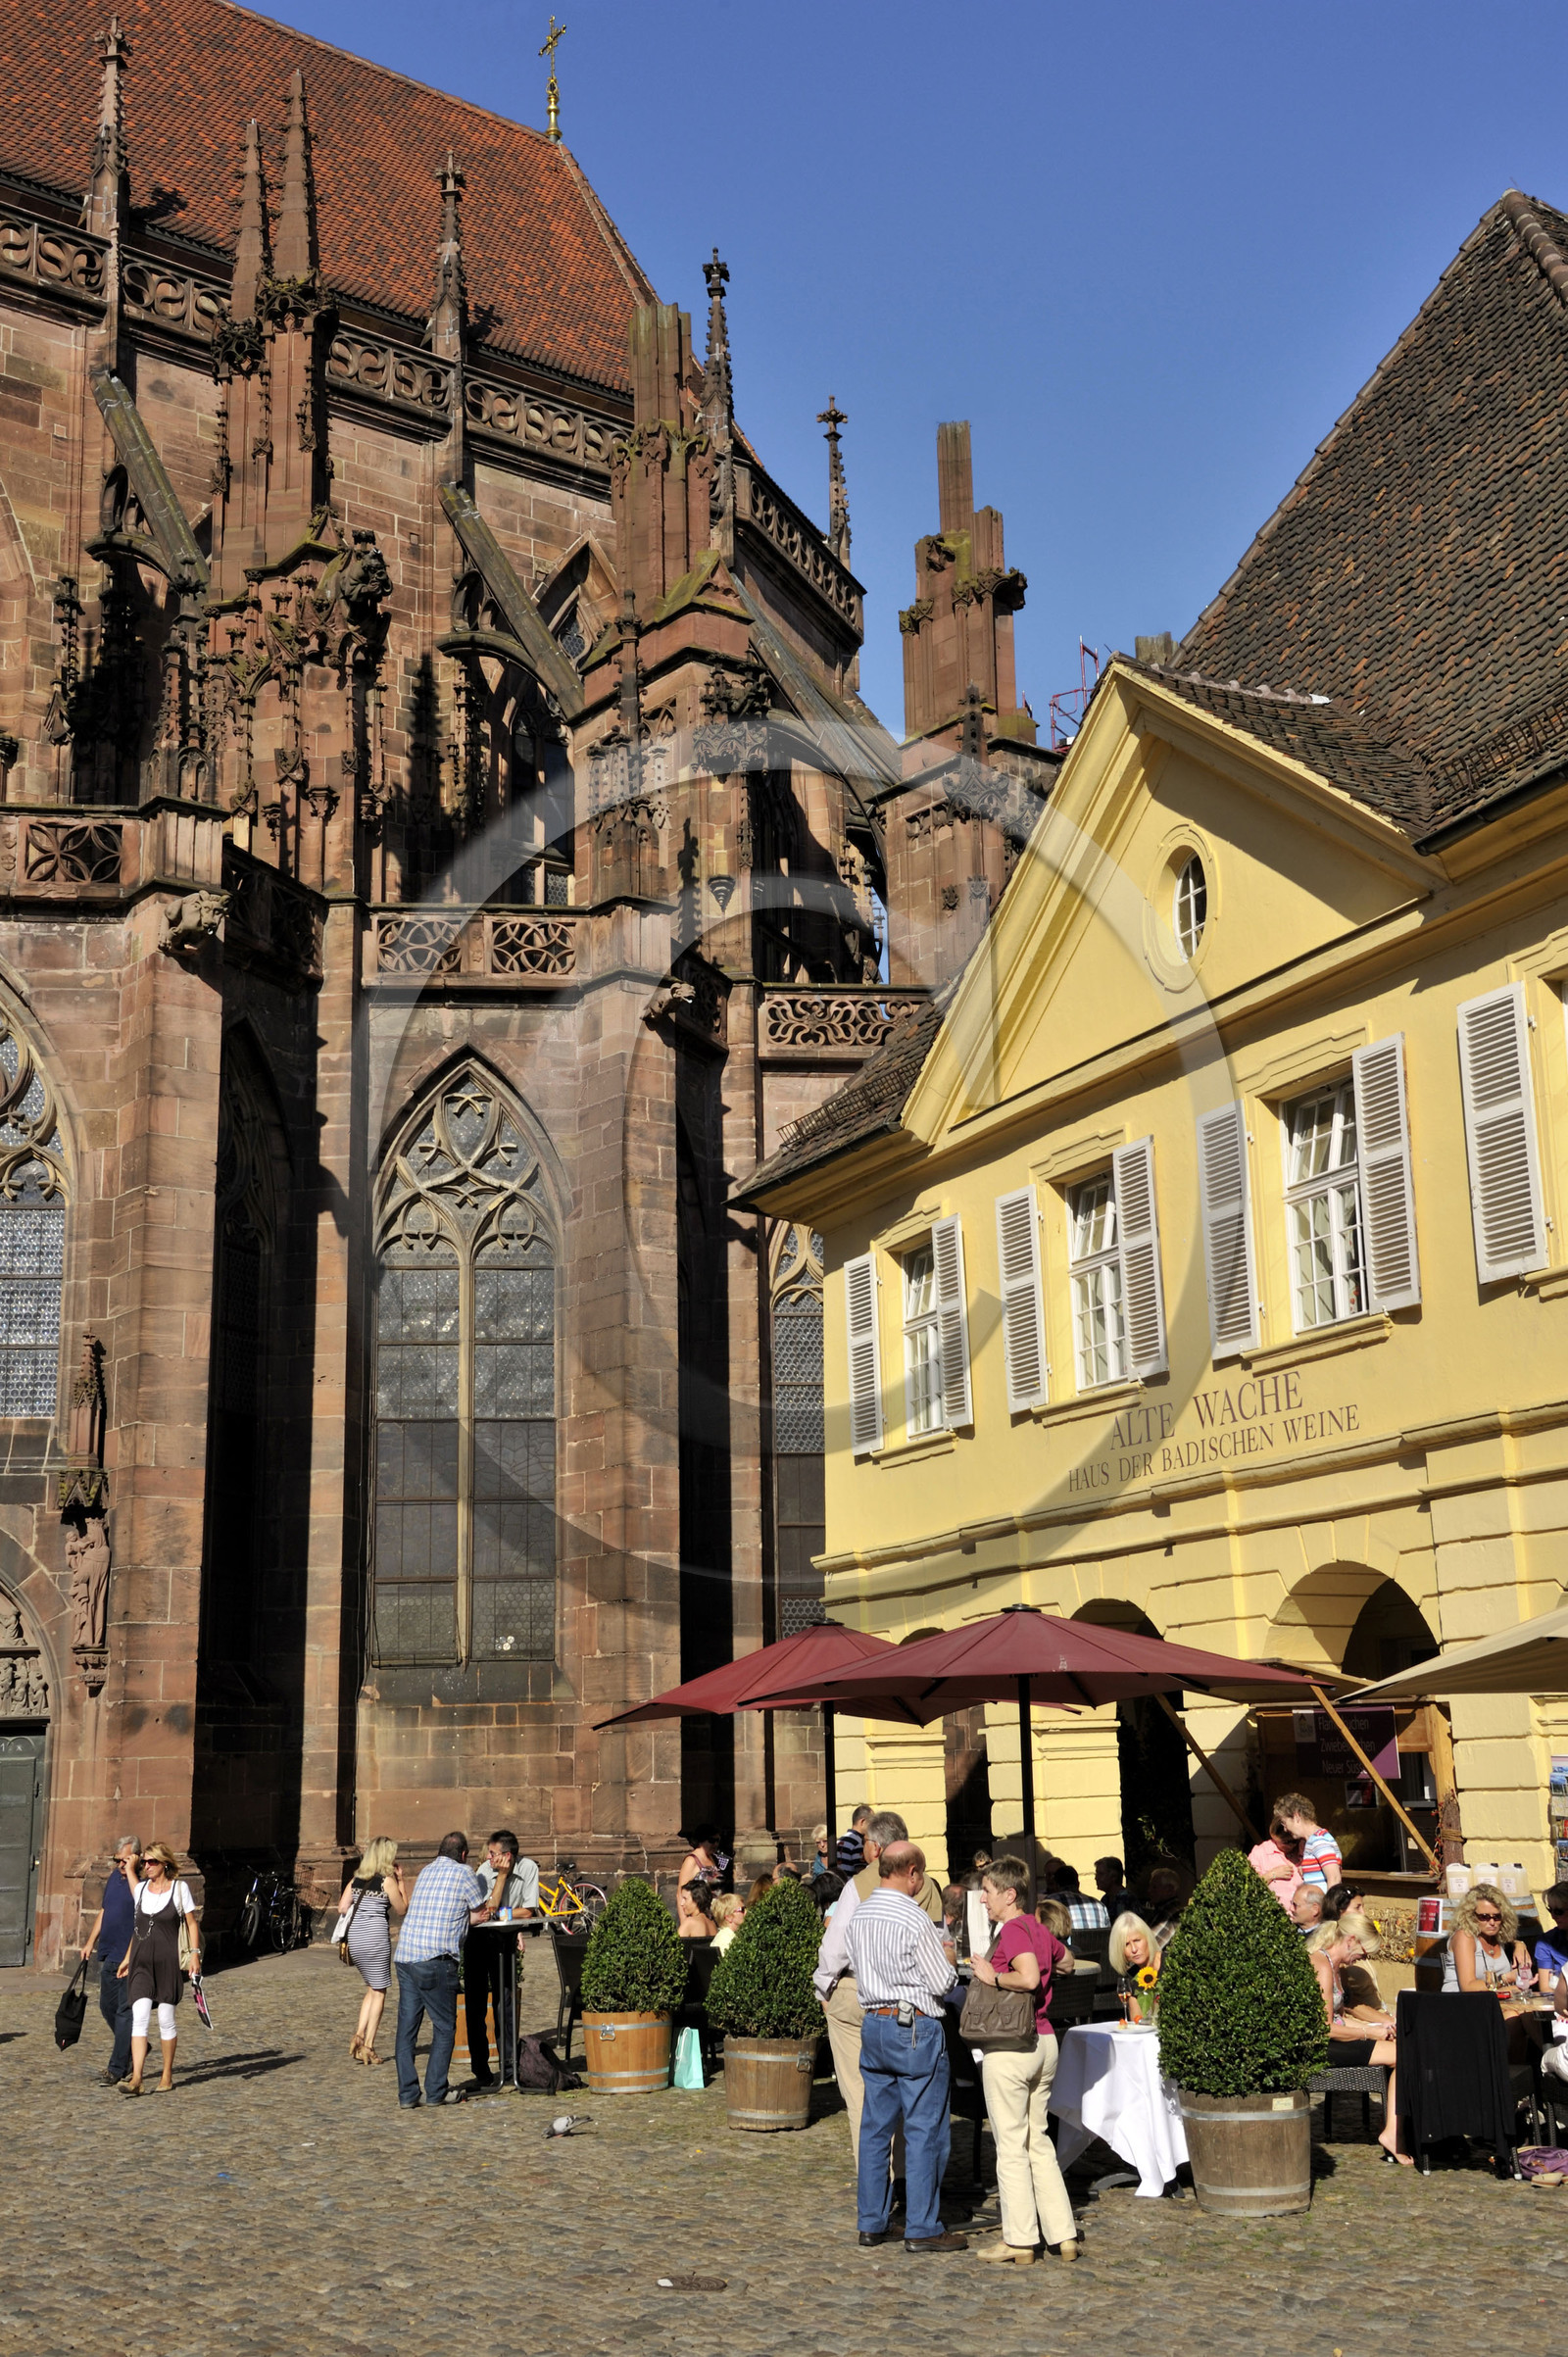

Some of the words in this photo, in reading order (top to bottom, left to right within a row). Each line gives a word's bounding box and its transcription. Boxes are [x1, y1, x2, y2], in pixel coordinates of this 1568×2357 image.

[1068, 1462, 1109, 1492] HAUS
[1119, 1452, 1153, 1482] DER
[1161, 1422, 1274, 1472] BADISCHEN
[1283, 1404, 1360, 1444] WEINE
[1109, 1402, 1175, 1450] ALTE
[1193, 1371, 1303, 1429] WACHE
